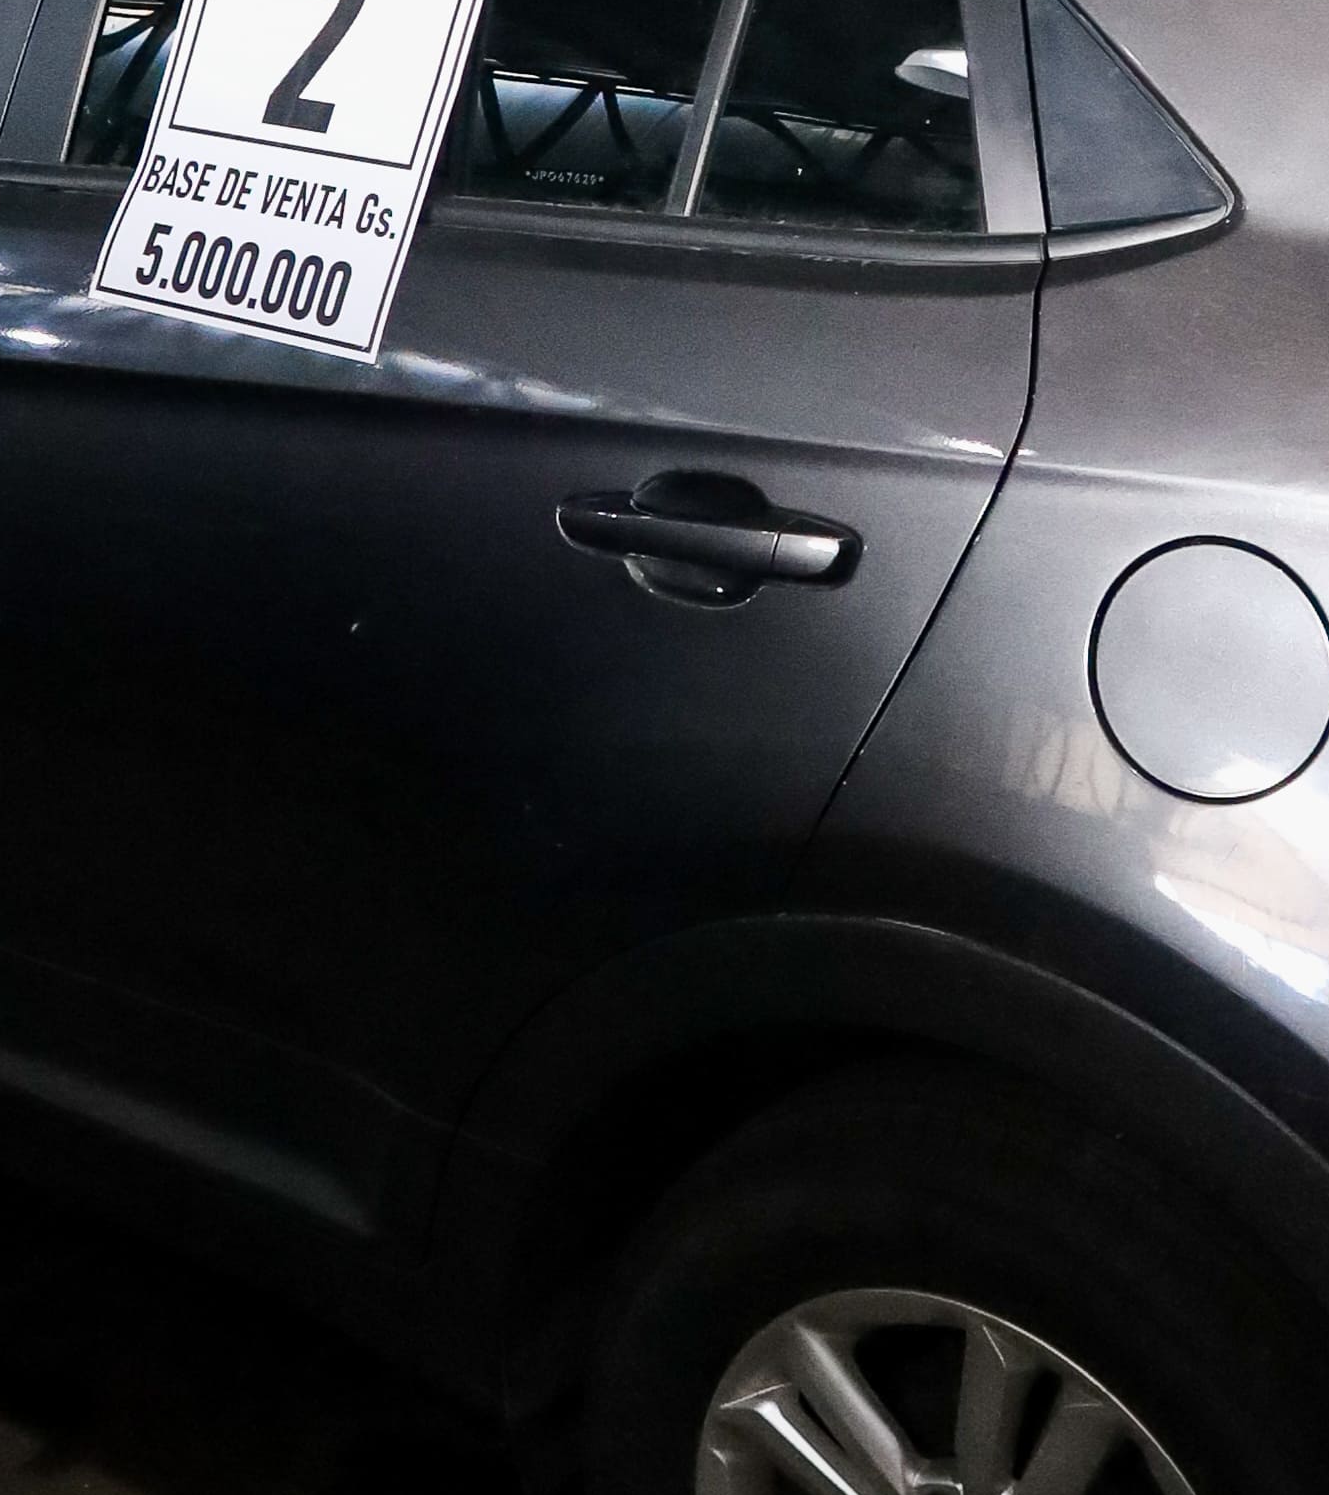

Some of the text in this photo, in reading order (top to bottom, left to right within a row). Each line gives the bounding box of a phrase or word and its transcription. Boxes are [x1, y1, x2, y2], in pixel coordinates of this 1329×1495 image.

[142, 154, 396, 240] BASE DE VENTA Gs.
[135, 222, 353, 327] 5.000.000
